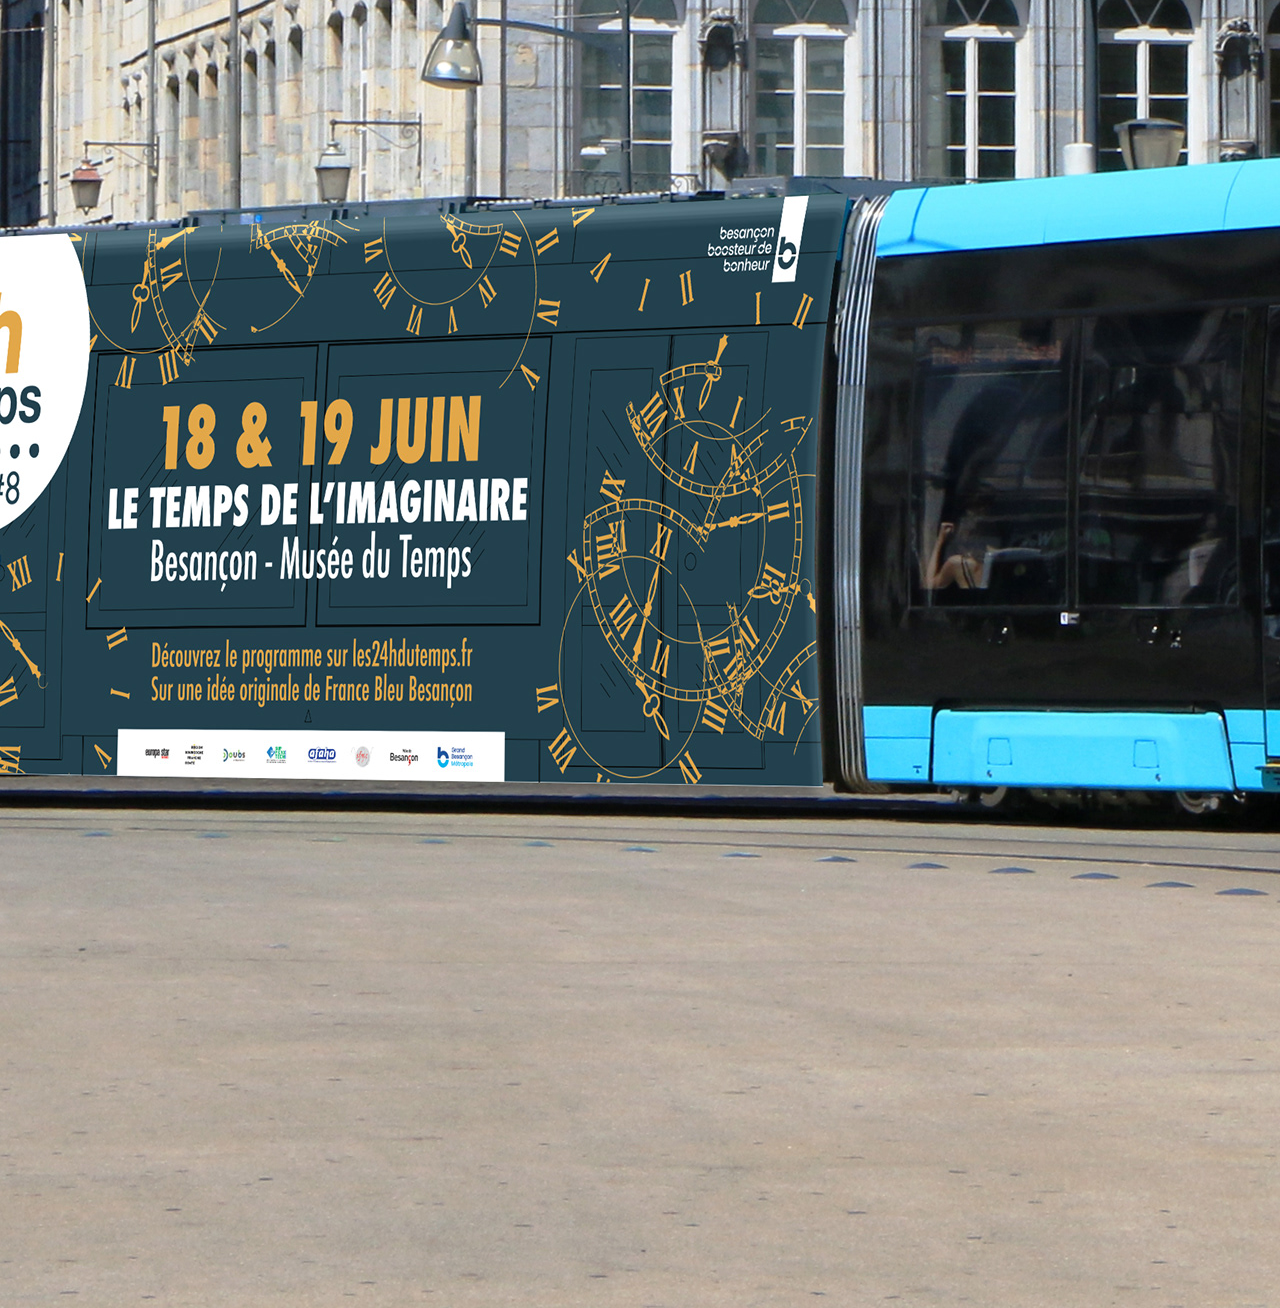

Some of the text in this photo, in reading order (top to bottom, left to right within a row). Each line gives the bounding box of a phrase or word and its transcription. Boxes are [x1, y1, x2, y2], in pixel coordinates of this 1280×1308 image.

[707, 241, 773, 257] boosteur de
[719, 226, 775, 243] besançon
[723, 258, 771, 272] bonheur
[163, 396, 482, 469] 18 & 19 JUIN
[108, 488, 138, 529] LE
[150, 484, 248, 528] TEMPS
[261, 483, 298, 525] DE
[150, 539, 256, 591] Besançon
[280, 535, 353, 579] Musée
[362, 531, 390, 578] du
[400, 534, 471, 588] Temps
[151, 638, 472, 673] Découvrez le programme sur les24hdutemps.fr
[151, 673, 473, 708] Sur une idée originale de France Bleu Besançon
